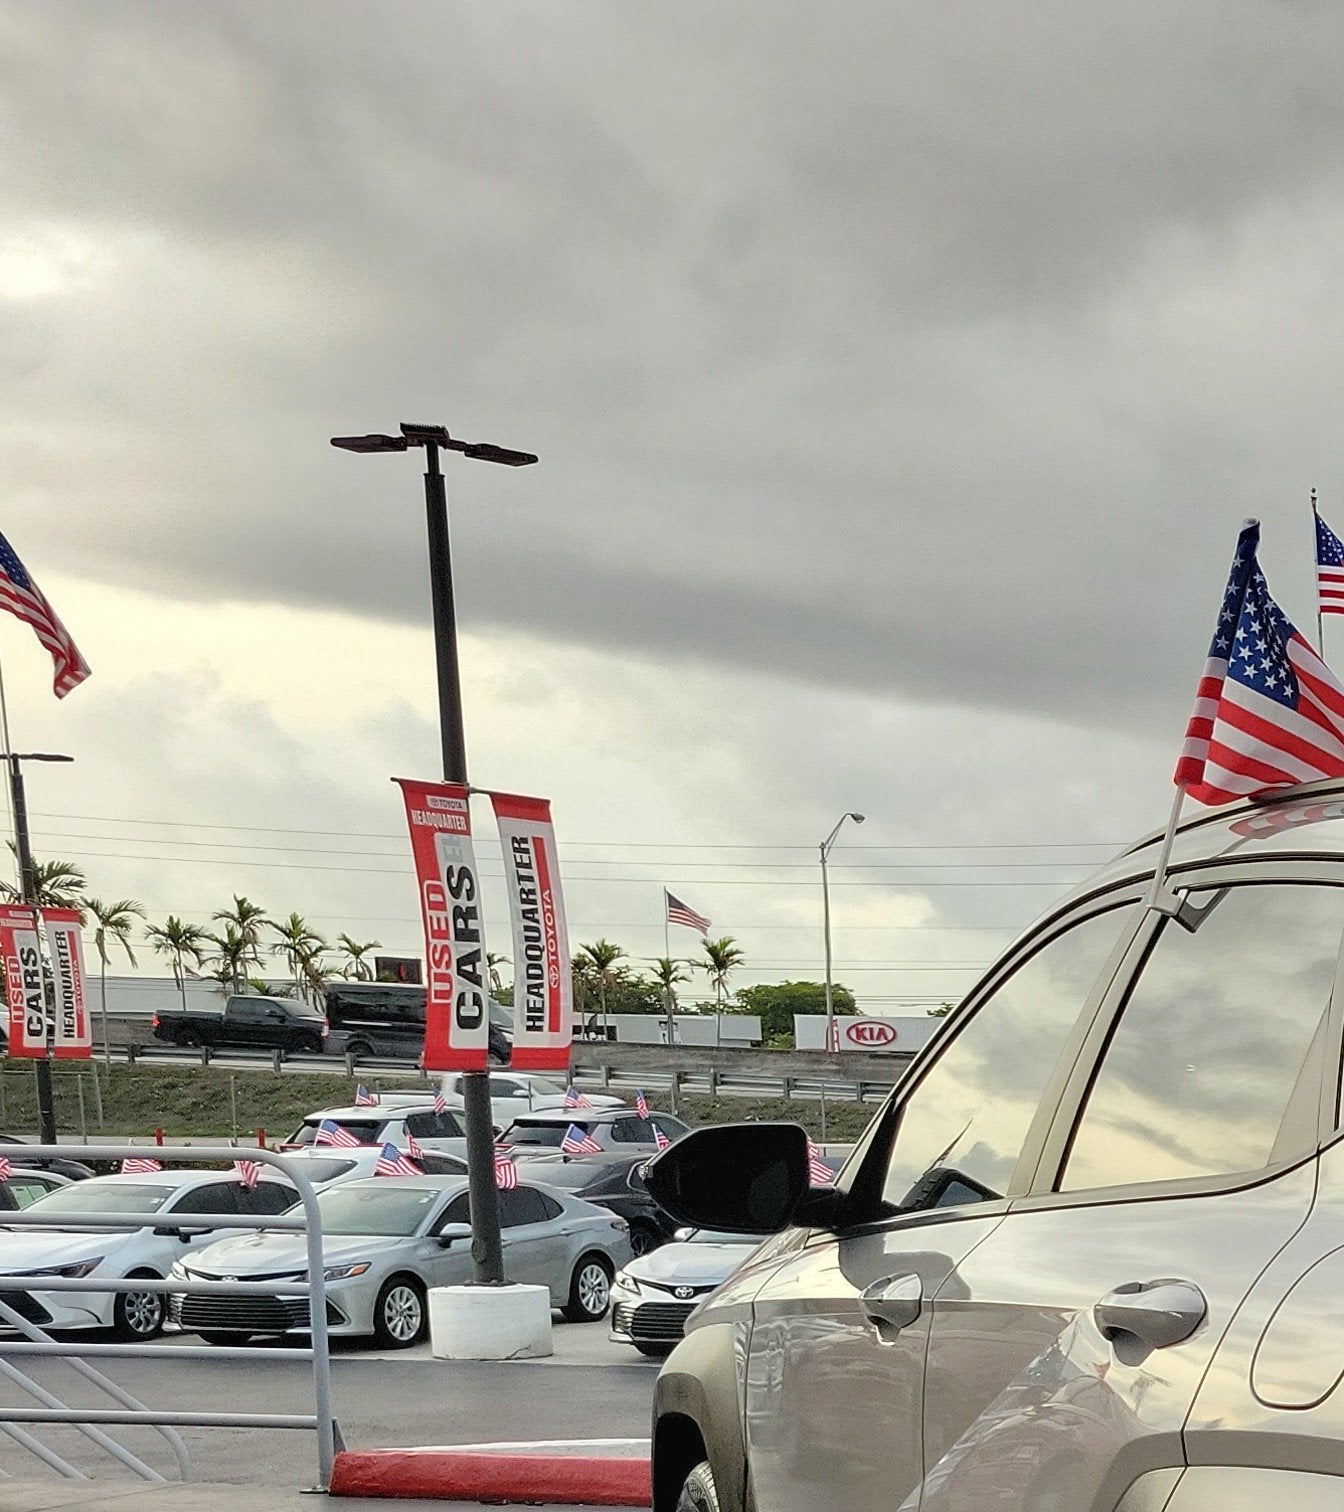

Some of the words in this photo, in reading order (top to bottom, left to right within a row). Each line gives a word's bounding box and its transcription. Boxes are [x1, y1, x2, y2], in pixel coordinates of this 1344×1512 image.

[424, 880, 453, 1003] USED
[447, 864, 484, 1031] CARS
[511, 836, 543, 1033] HEADQUARTER
[541, 890, 559, 968] TOYOTA
[7, 956, 25, 1023] USED
[20, 947, 44, 1037] CARS
[55, 931, 75, 1039] HEADQUARTER
[855, 1027, 890, 1041] KIA
